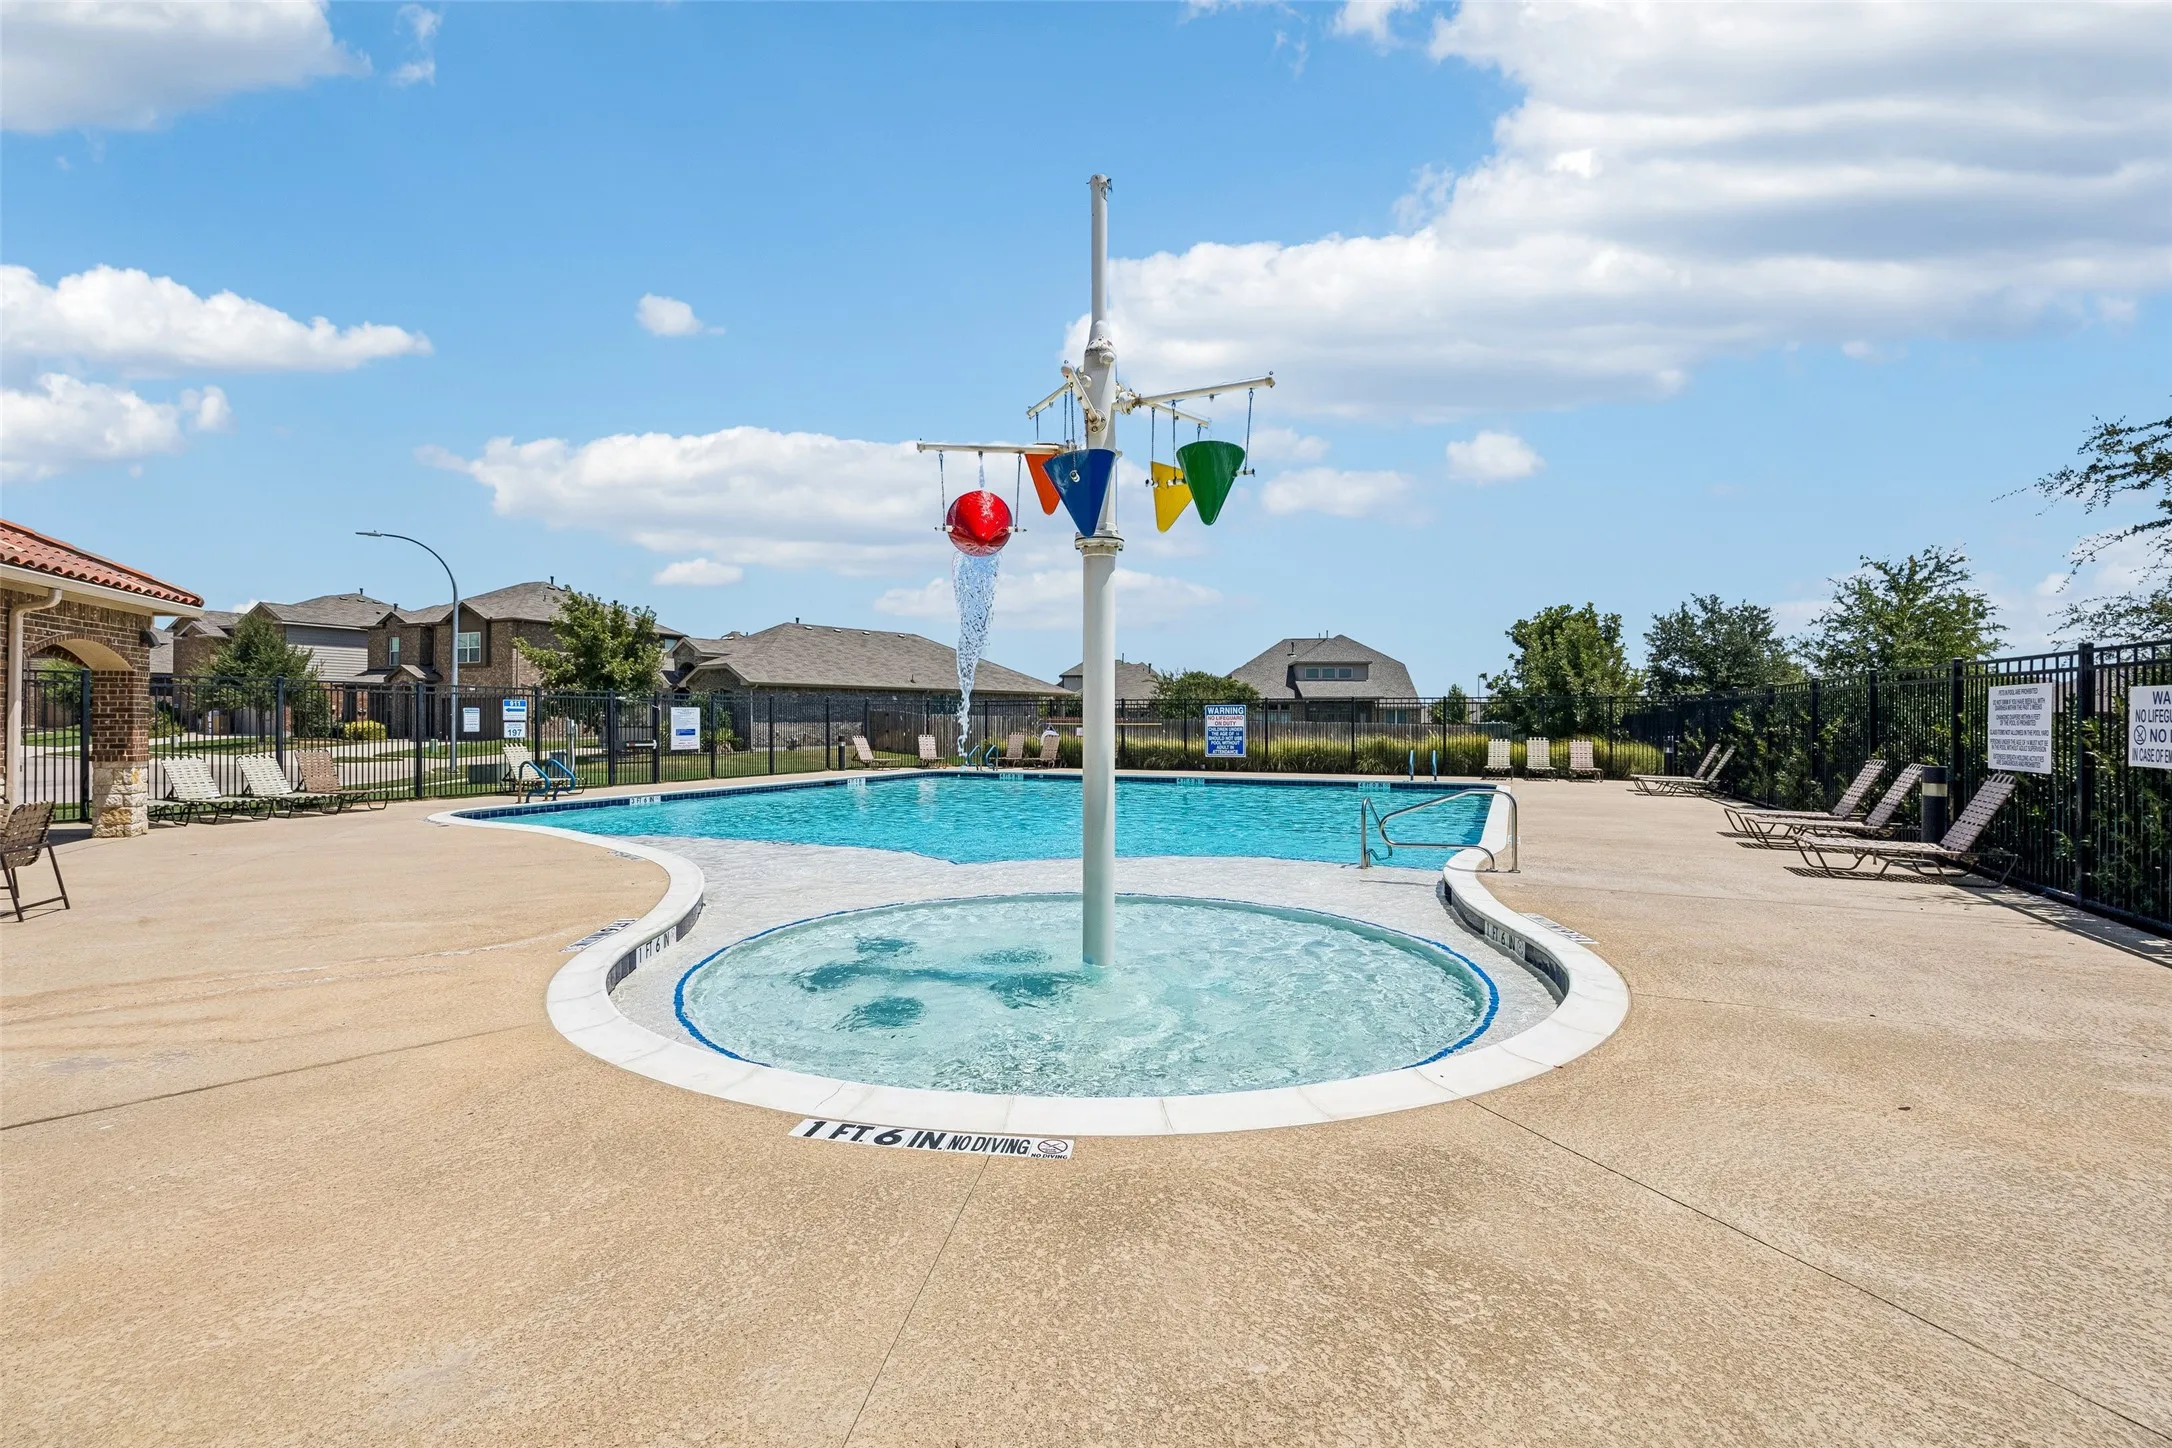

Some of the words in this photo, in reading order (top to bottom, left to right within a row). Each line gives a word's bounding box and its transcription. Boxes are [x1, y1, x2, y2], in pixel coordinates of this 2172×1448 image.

[2135, 709, 2146, 722] NO
[2150, 729, 2166, 742] NO
[2132, 748, 2138, 760] IN
[2139, 748, 2154, 762] CASE
[2156, 749, 2163, 762] OF
[1501, 931, 1505, 945] 6
[646, 942, 652, 959] FT
[656, 937, 660, 952] 6
[664, 932, 670, 948] IN
[803, 1120, 827, 1137] 1
[828, 1123, 876, 1142] FT.
[873, 1129, 905, 1145] 6
[906, 1131, 947, 1150] IN.
[946, 1135, 972, 1151] NO
[971, 1136, 1031, 1155] DIVING
